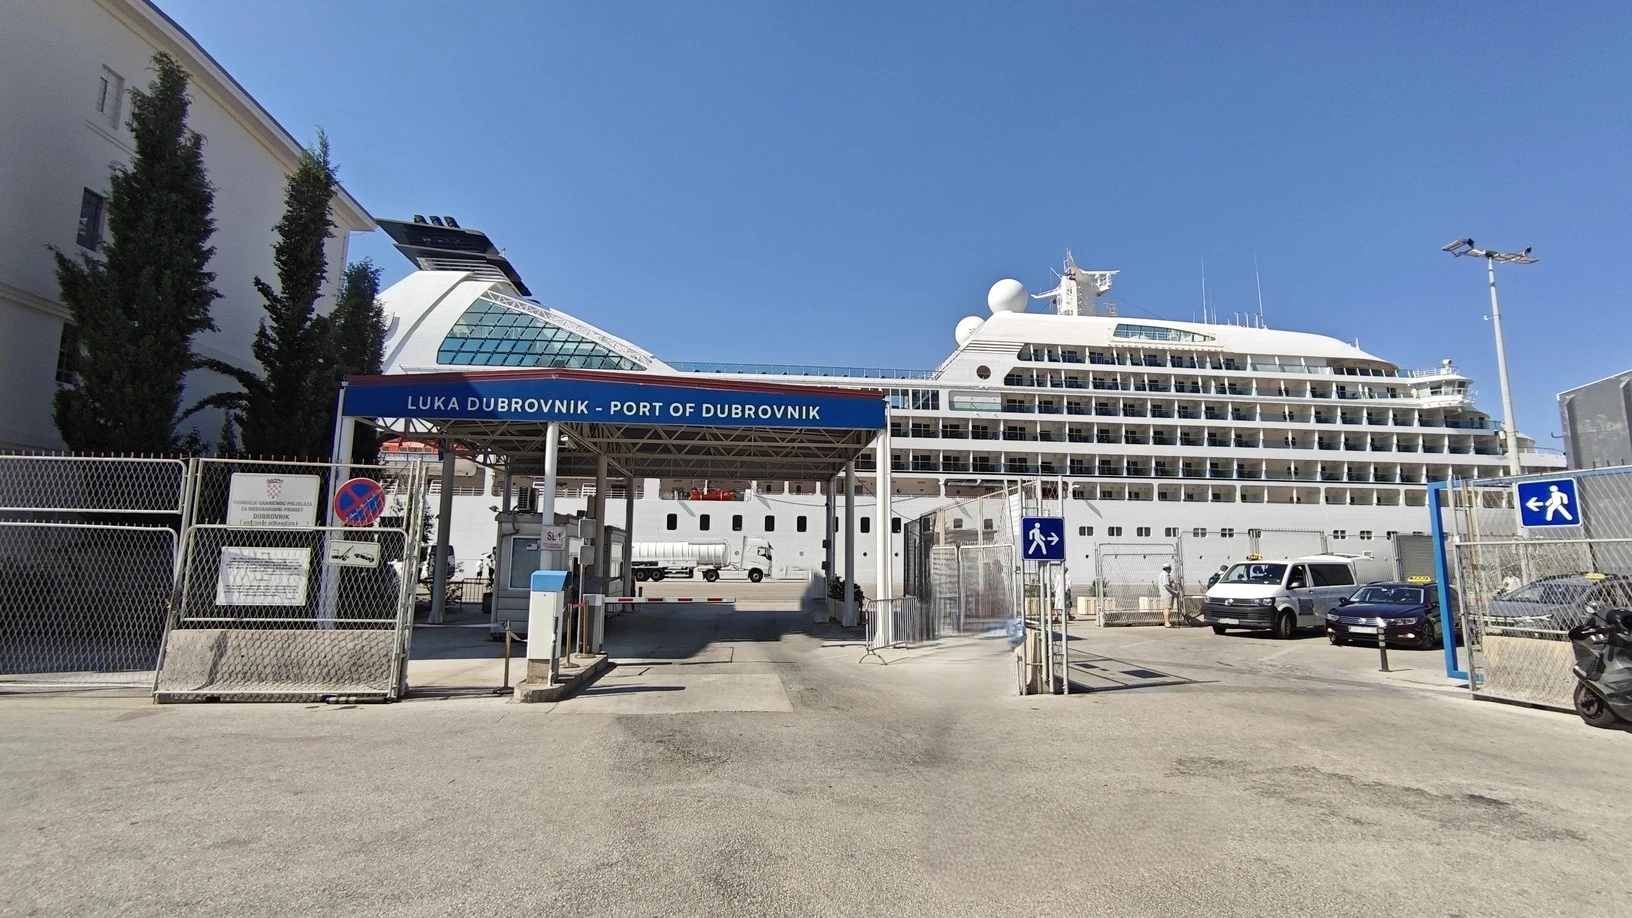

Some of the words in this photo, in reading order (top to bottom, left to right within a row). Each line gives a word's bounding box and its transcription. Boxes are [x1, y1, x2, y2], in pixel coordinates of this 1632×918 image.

[407, 395, 460, 411] LUKA
[467, 397, 589, 415] DUBROVNIK
[610, 401, 663, 416] PORT
[669, 402, 696, 417] OF
[701, 403, 821, 420] DUBROVNIK
